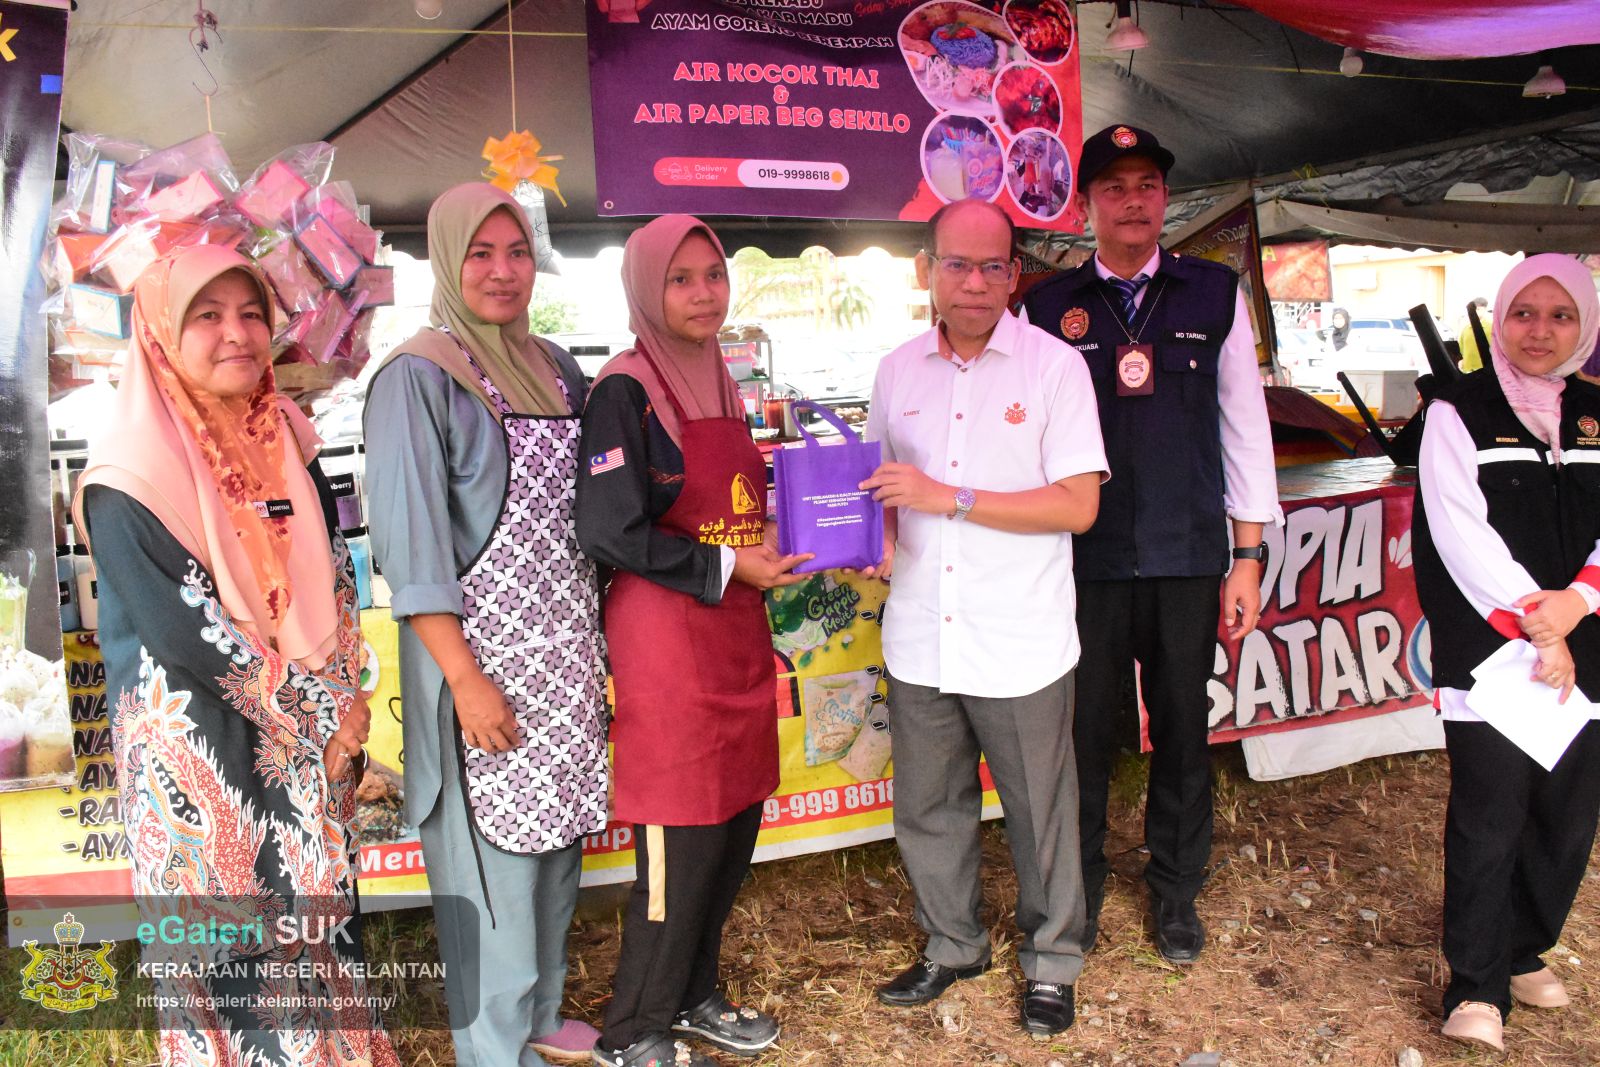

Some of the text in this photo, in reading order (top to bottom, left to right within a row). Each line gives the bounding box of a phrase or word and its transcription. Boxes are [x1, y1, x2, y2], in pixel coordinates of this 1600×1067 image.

[651, 13, 710, 30] AYAM
[796, 31, 895, 49] BEREMPAH
[798, 12, 853, 26] MADU
[673, 62, 880, 88] AIR KOCOK THAI
[773, 85, 789, 104] &
[634, 103, 911, 133] AIR PAPER BEG SEKILO
[694, 164, 728, 175] Delivery
[695, 173, 719, 181] Order
[758, 168, 830, 181] 019-9998618
[699, 534, 742, 546] BAZAR
[807, 582, 852, 621] Green
[825, 590, 861, 617] apple
[822, 606, 857, 637] Mojito
[58, 795, 124, 826] -RA
[761, 787, 839, 824] 9-999
